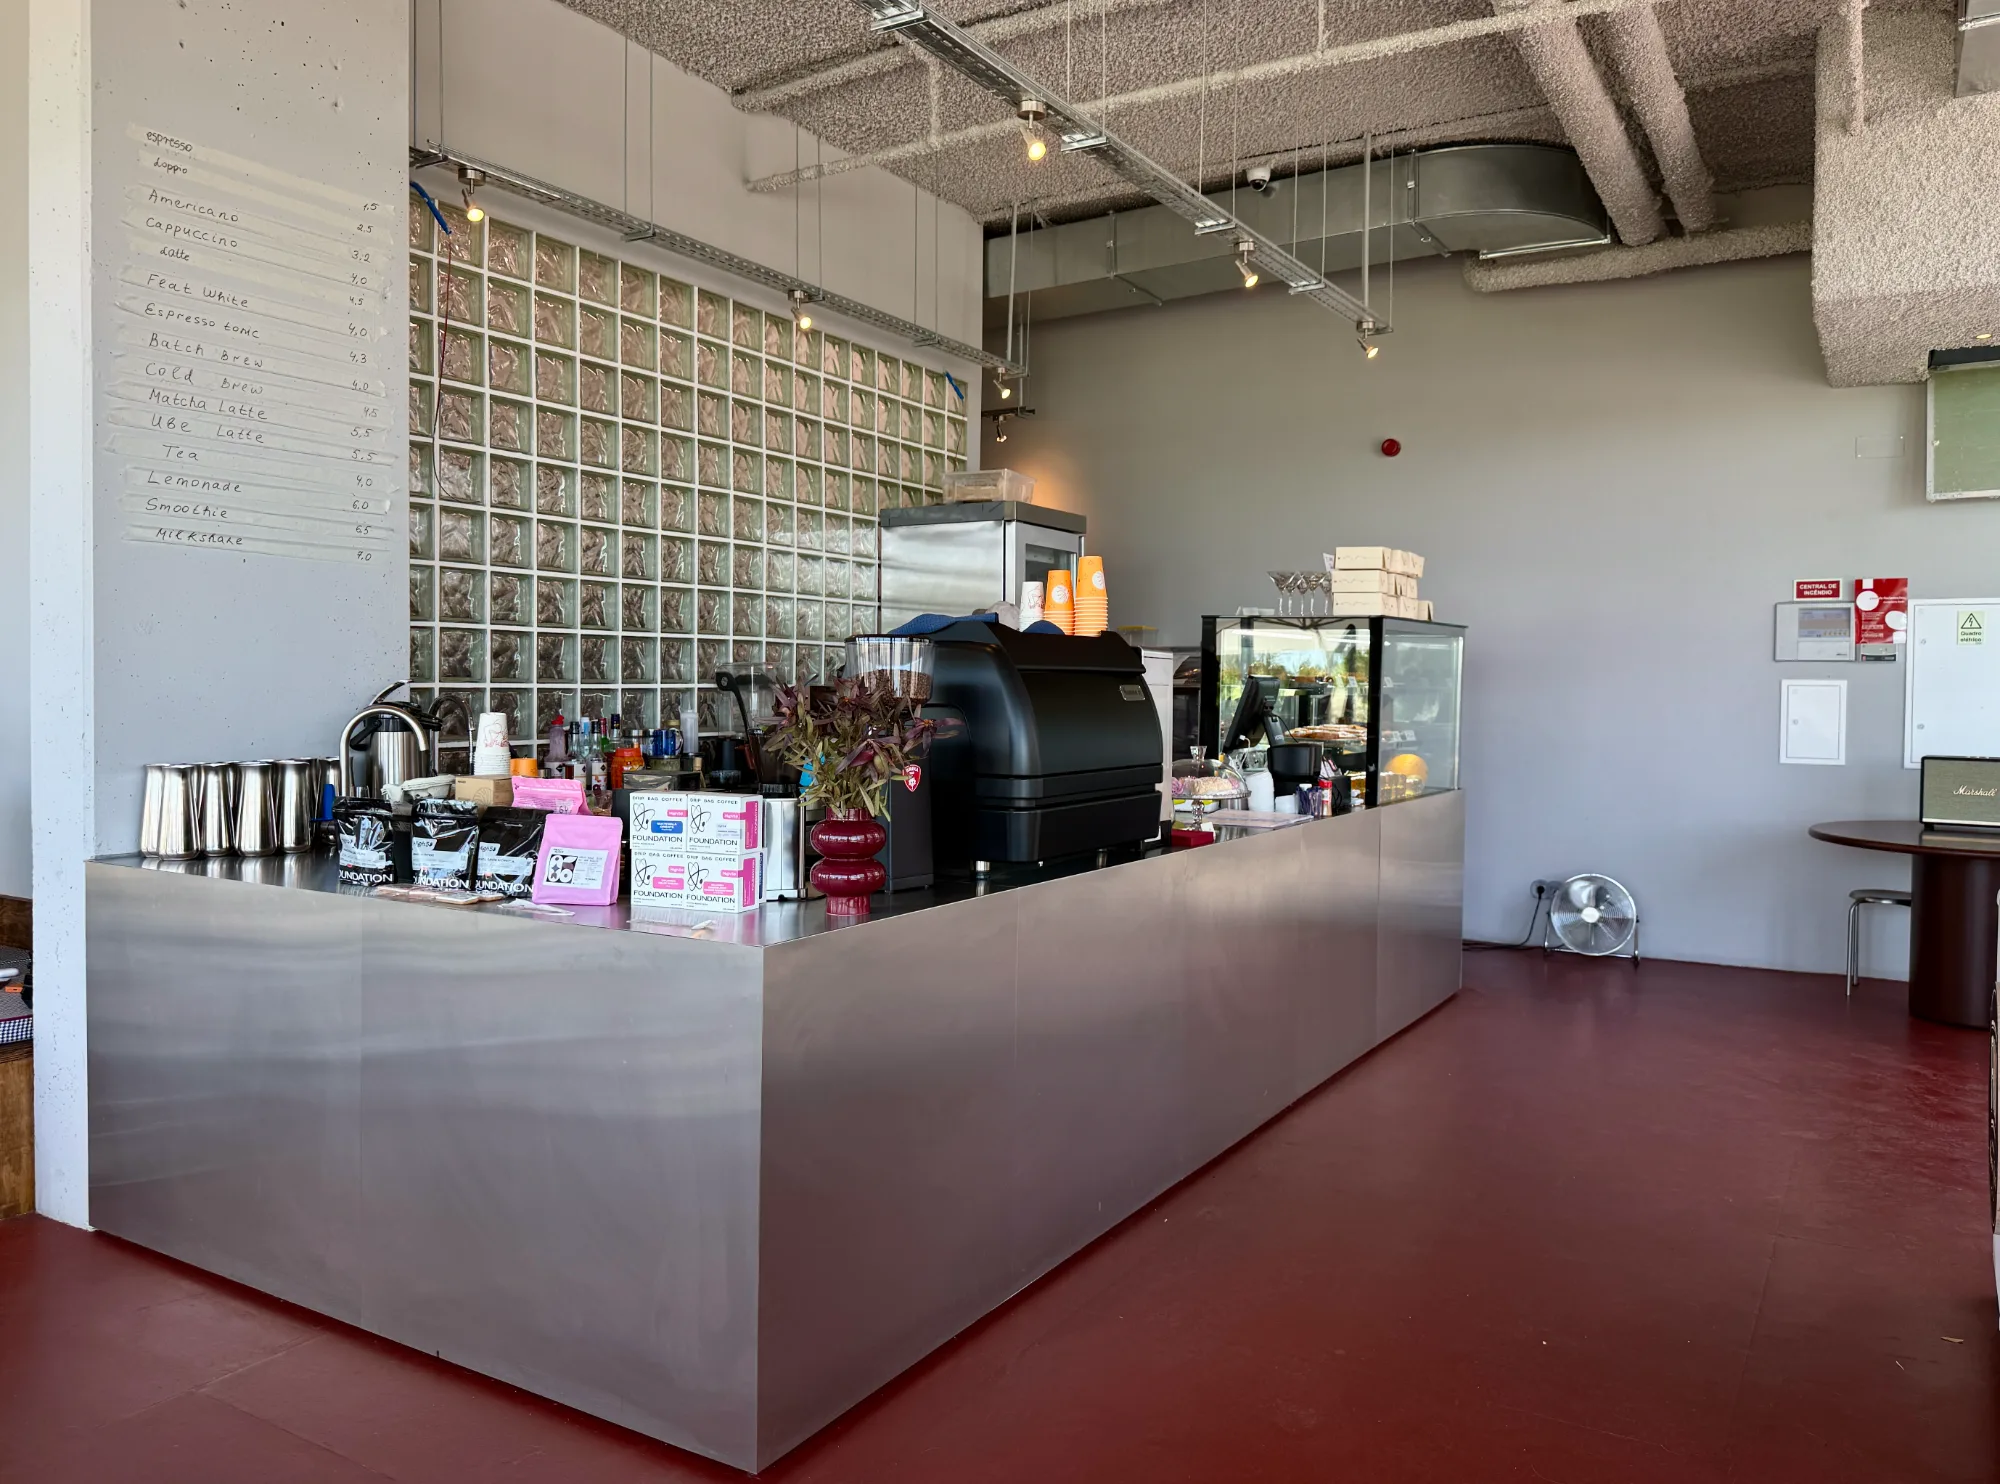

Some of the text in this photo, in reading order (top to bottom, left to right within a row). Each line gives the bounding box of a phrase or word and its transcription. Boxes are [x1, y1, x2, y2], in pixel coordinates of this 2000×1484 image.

[146, 130, 193, 152] espresso
[153, 157, 188, 175] doppio
[149, 189, 239, 222] Americano
[146, 217, 238, 248] Cappuccino
[145, 303, 216, 328] Espresso
[224, 321, 260, 339] tonic
[149, 332, 205, 357] Batch
[220, 349, 264, 368] Brew
[146, 362, 195, 385] Cold
[221, 378, 264, 395] Brew
[149, 388, 207, 411] Matcha
[218, 400, 268, 420] Latte
[216, 424, 264, 444] Latte
[162, 444, 199, 461] Tea
[148, 470, 242, 493] Lemonade
[145, 497, 228, 519] Smoothie
[1953, 785, 1998, 797] Marshall
[632, 834, 683, 843] FOUNDATION
[689, 837, 738, 846] FOUNDATION
[339, 869, 393, 882] UNDATION
[412, 876, 470, 889] UNDATION
[475, 880, 533, 892] UNDATION
[633, 890, 683, 899] FOUNDATION
[686, 894, 736, 904] FOUNDATION
